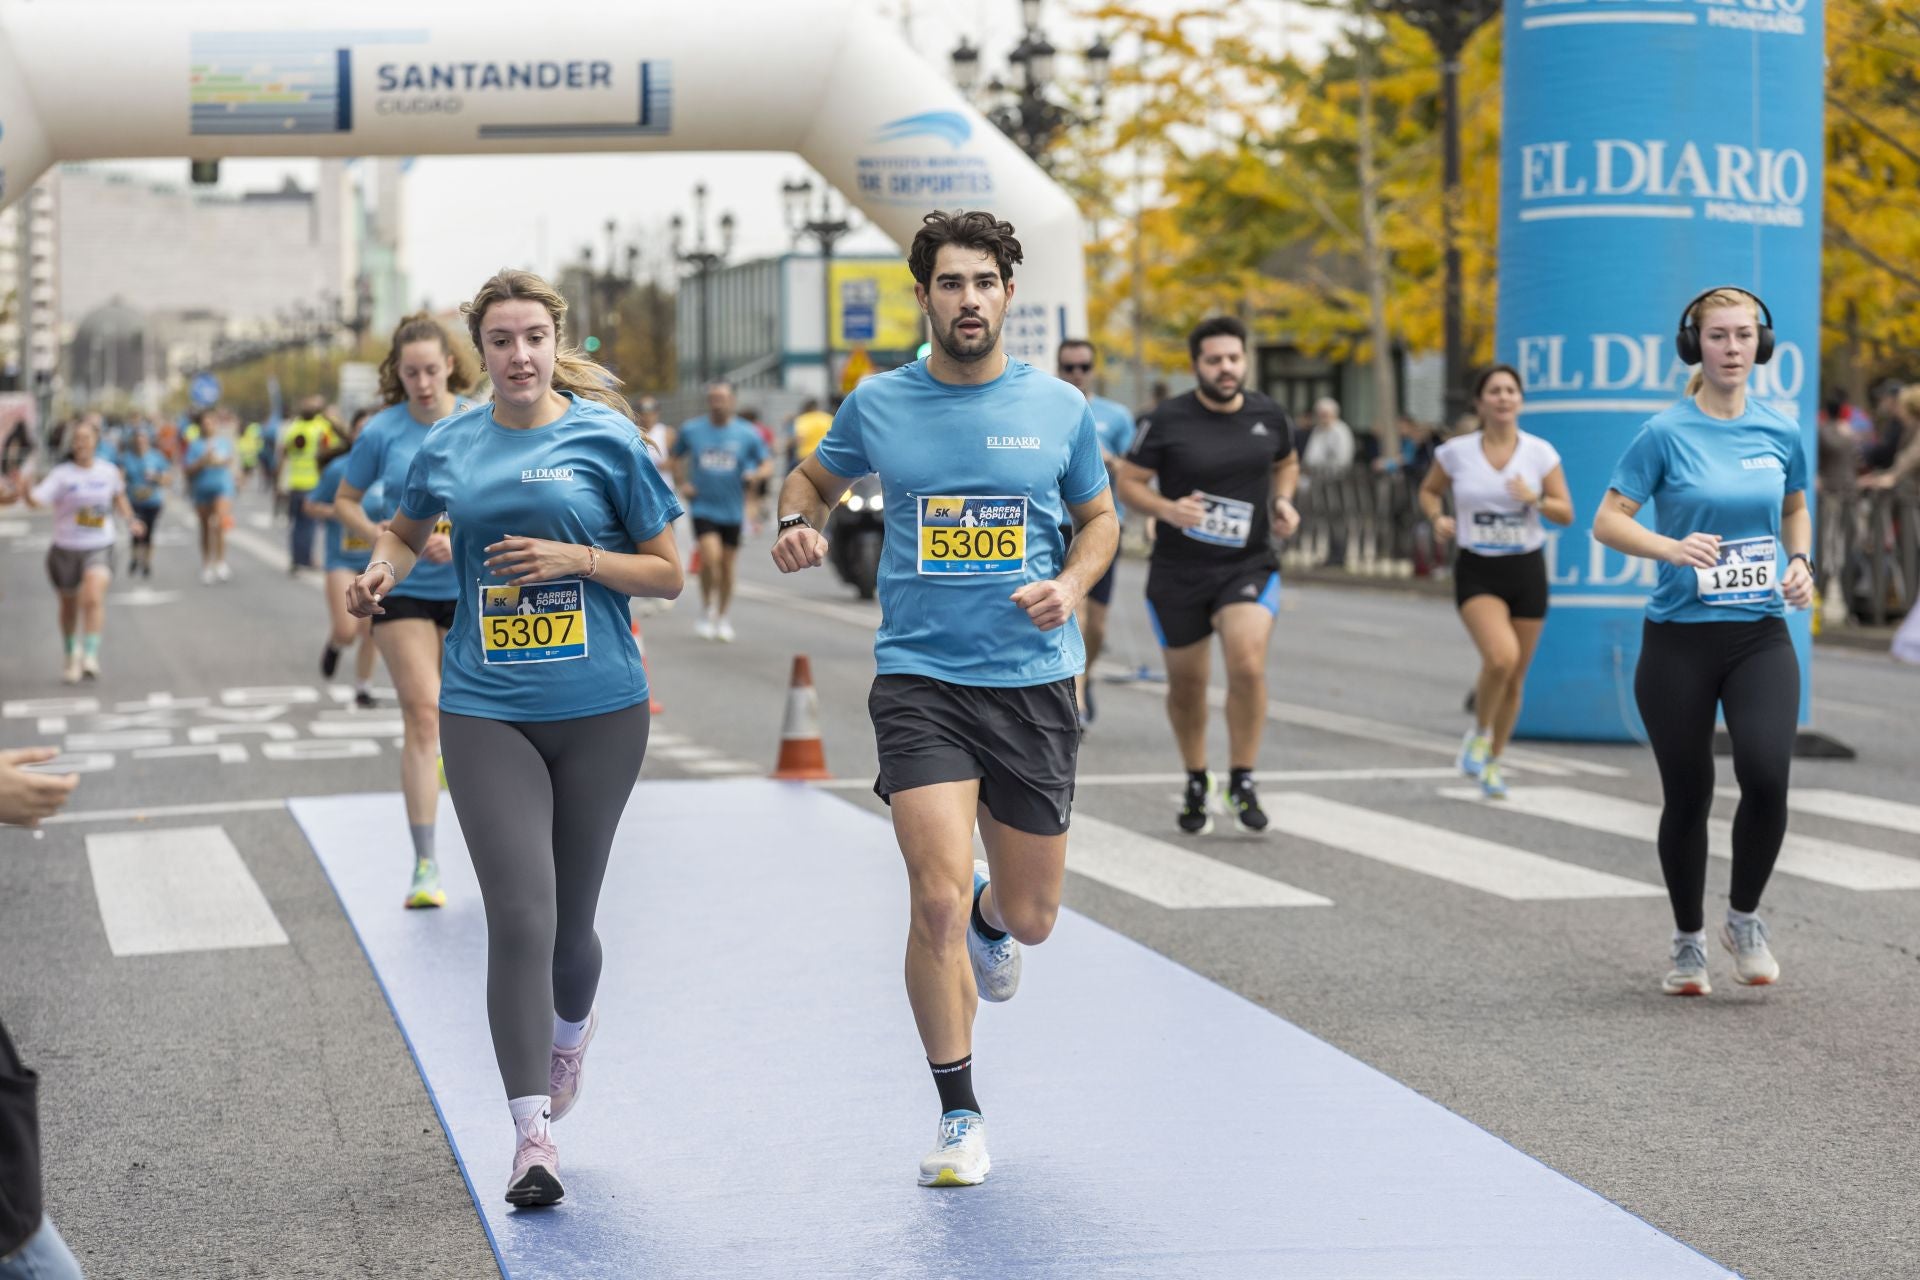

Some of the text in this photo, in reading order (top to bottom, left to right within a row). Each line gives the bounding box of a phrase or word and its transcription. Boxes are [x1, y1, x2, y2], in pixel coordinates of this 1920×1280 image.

[377, 62, 614, 91] SANTANDER
[375, 97, 463, 115] CIUDAD
[1520, 138, 1809, 206] EL DIARIO
[1518, 334, 1582, 392] EL
[986, 436, 1041, 447] EL DIARIO
[521, 468, 574, 479] EL DIARIO
[934, 508, 950, 518] 5K
[979, 512, 1020, 520] POPULAR
[930, 529, 1017, 558] 5306
[1711, 566, 1767, 590] 1256
[493, 597, 507, 607] 5K
[535, 596, 578, 607] POPULAR
[536, 590, 578, 600] CARRERA
[492, 614, 575, 648] 5307
